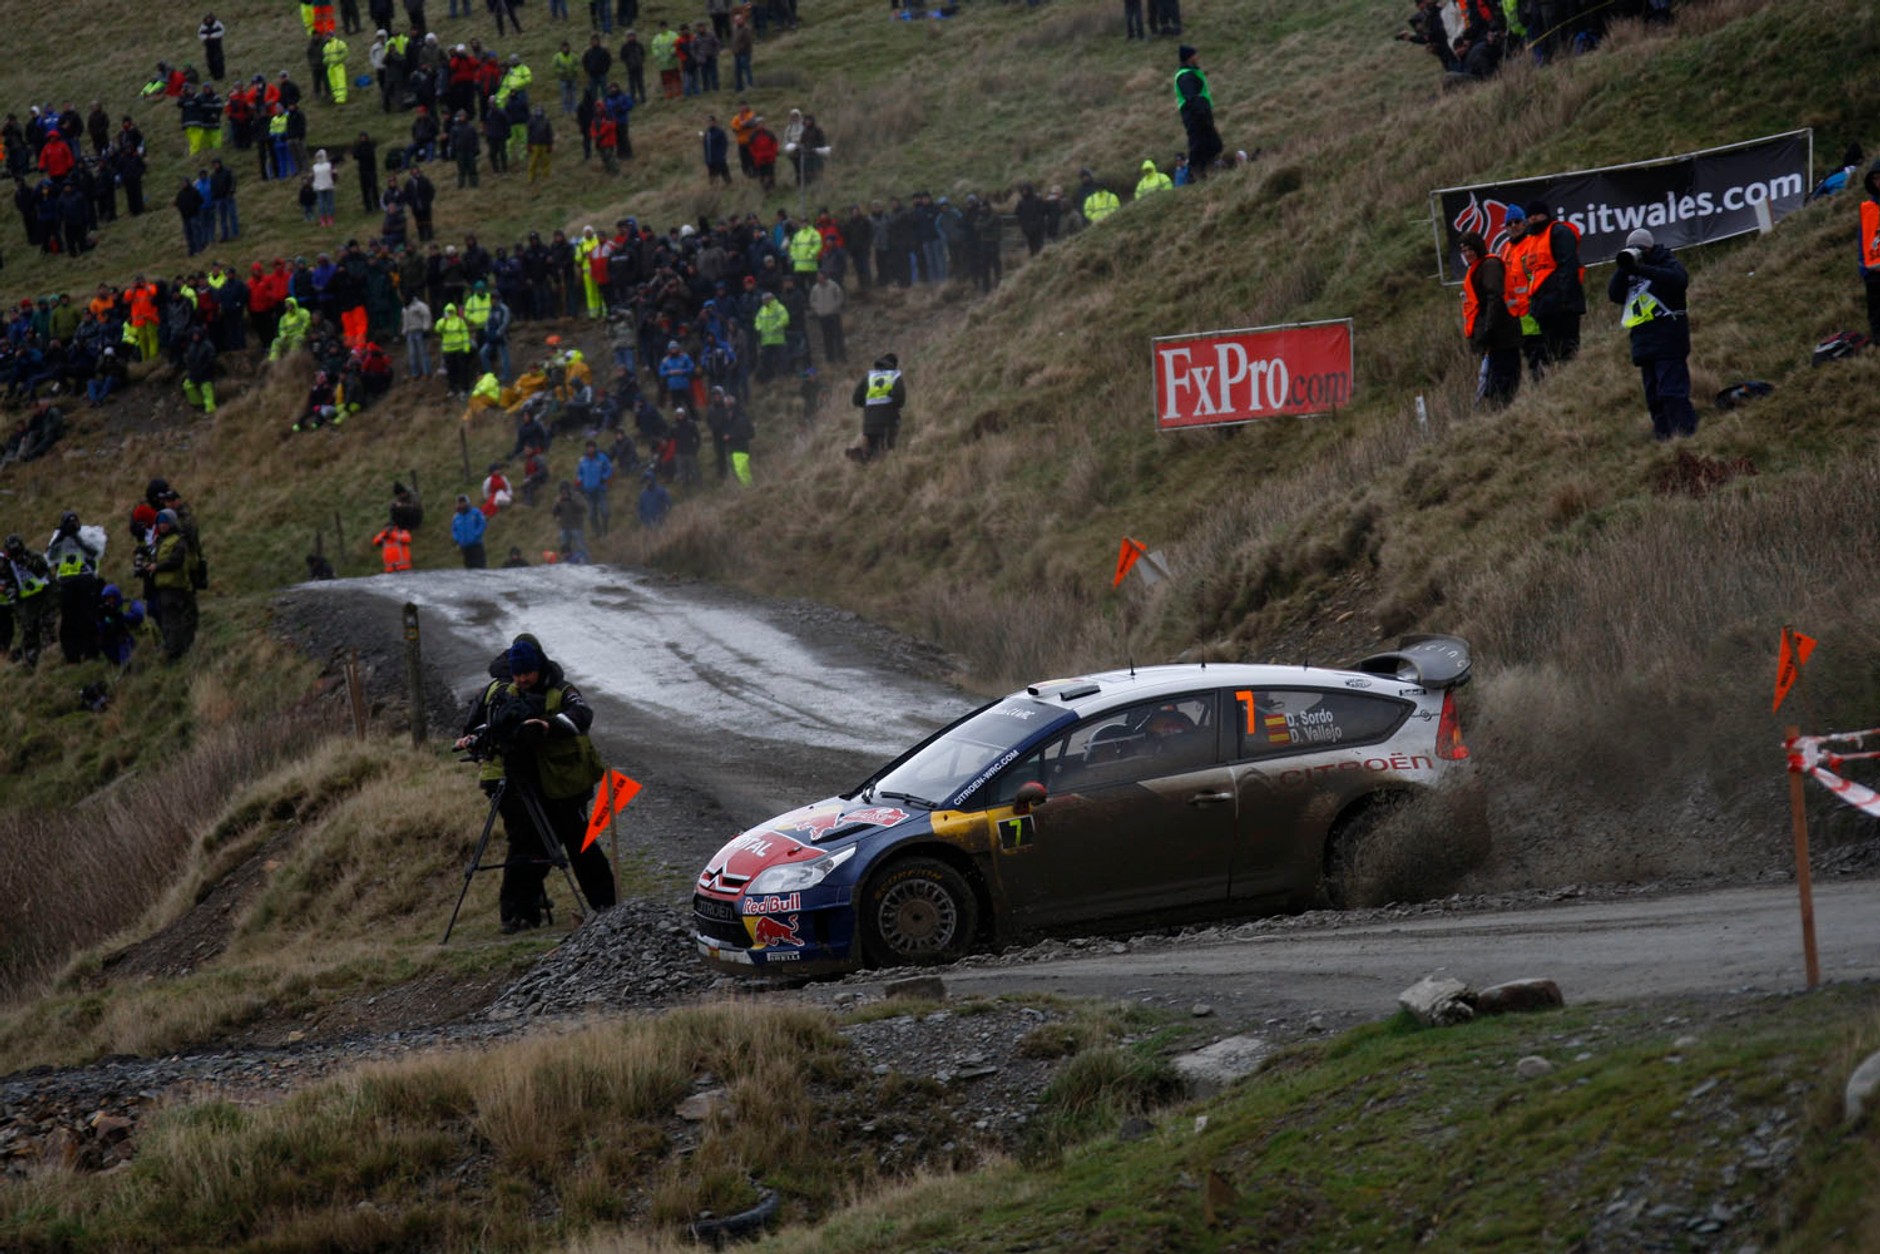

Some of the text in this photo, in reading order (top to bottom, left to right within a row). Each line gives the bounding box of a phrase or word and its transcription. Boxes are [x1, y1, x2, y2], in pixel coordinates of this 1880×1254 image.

[1556, 172, 1802, 236] isitwales.com
[1160, 342, 1347, 419] FxPro.com
[1235, 690, 1255, 735] 7
[1285, 708, 1333, 727] D. Sordo
[1290, 724, 1342, 743] D. Vallejo
[953, 749, 1019, 806] CITROEN-WRC.COM
[1008, 819, 1021, 846] 7
[743, 892, 801, 915] Red Bull
[766, 950, 800, 962] PIRELLI
